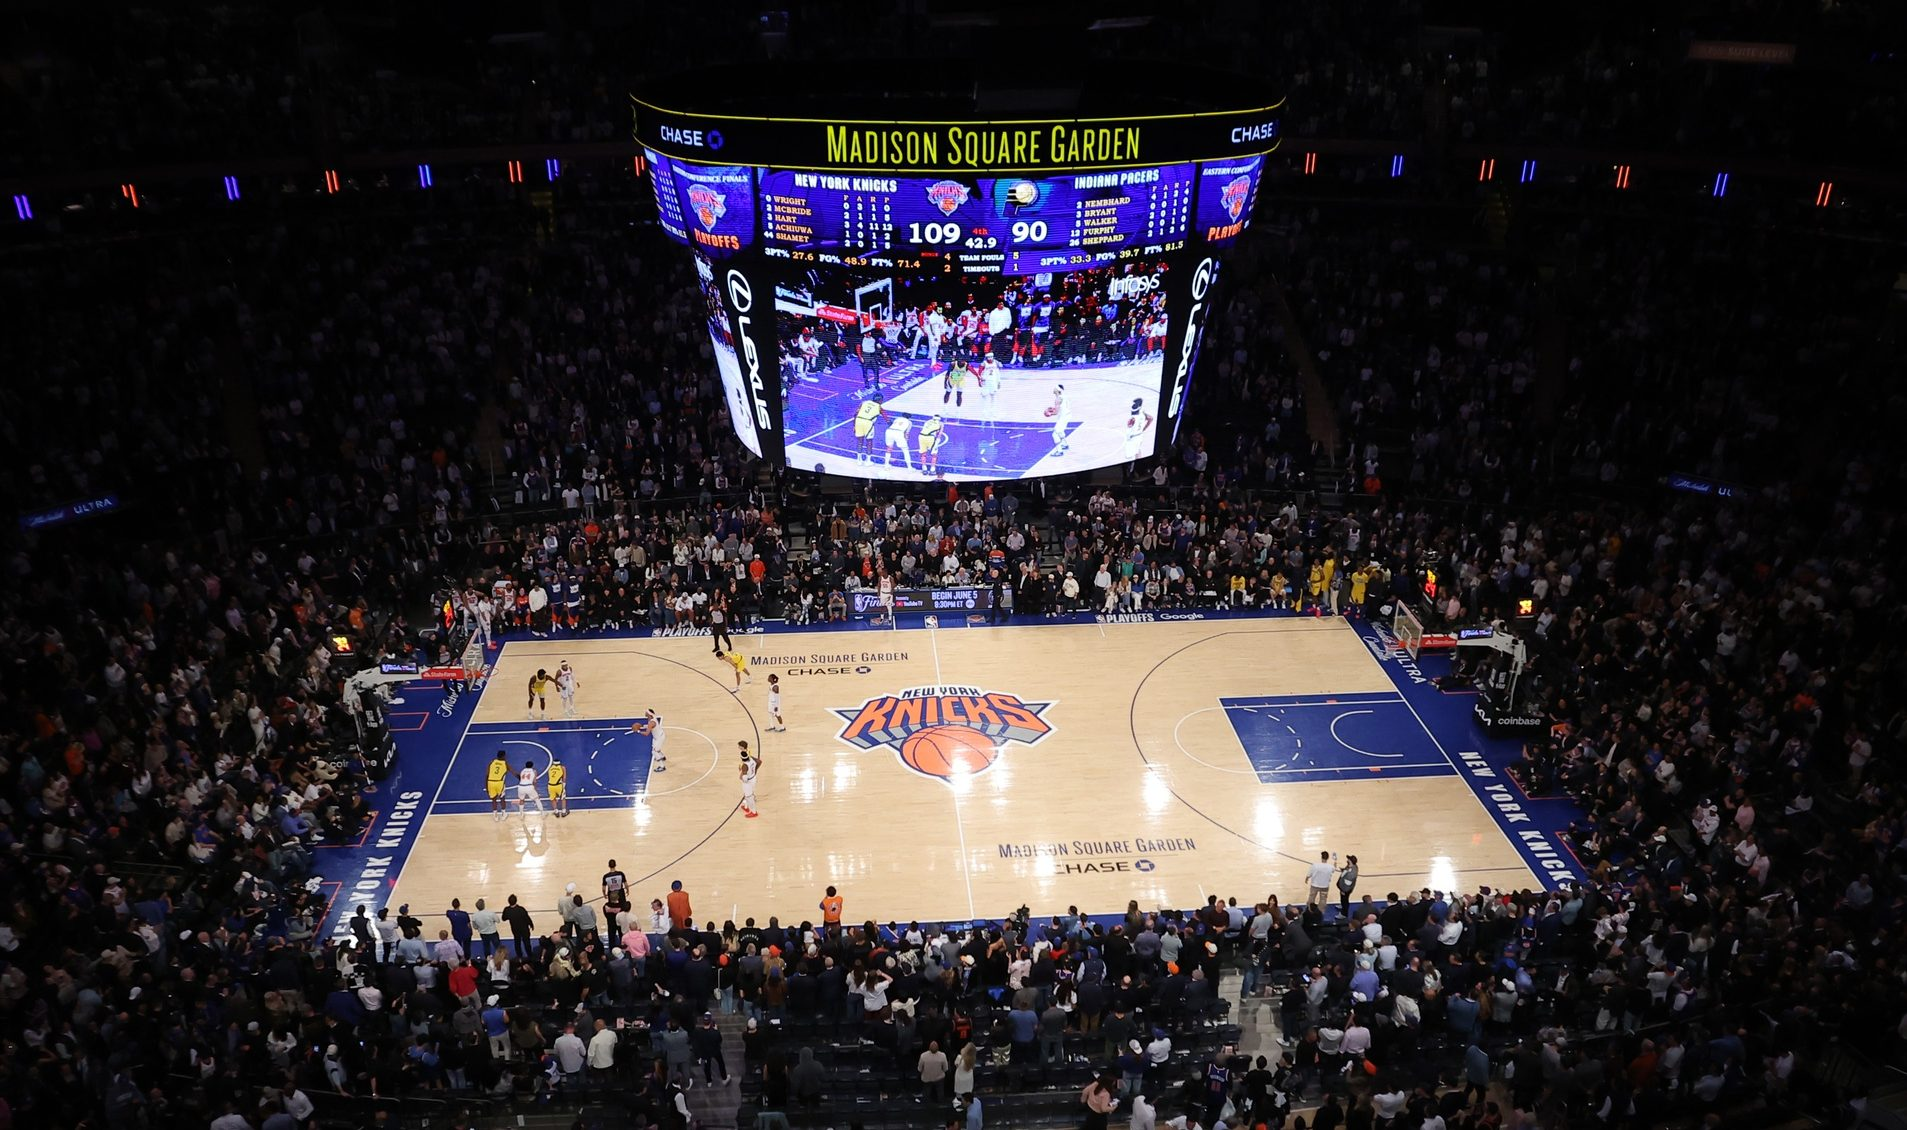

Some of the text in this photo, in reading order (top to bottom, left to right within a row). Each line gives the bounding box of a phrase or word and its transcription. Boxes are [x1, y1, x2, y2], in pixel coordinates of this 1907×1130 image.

[660, 125, 704, 147] CHASE
[1231, 122, 1273, 144] CHASE
[827, 124, 1140, 168] MADISON SQUARE GARDEN
[722, 175, 748, 183] FINALS
[795, 173, 898, 193] NEW YORK KNICKS
[1074, 169, 1160, 190] INDIANA PACERS
[765, 194, 772, 202] 0
[773, 195, 806, 206] WRIGHT
[843, 202, 850, 210] 0
[883, 204, 891, 212] 0
[1076, 201, 1082, 209] 2
[1085, 197, 1131, 208] NEMBHARD
[1151, 193, 1157, 201] 4
[1173, 190, 1179, 198] 2
[1184, 187, 1190, 196] 4
[766, 203, 772, 212] 2
[774, 204, 812, 216] MCBRIDE
[843, 211, 850, 219] 2
[1076, 210, 1082, 219] 3
[1084, 207, 1117, 218] BRYANT
[1150, 202, 1156, 210] 0
[1161, 200, 1167, 209] 0
[1182, 197, 1188, 205] 0
[767, 213, 773, 221] 3
[774, 214, 797, 223] HART
[857, 222, 864, 230] 4
[869, 222, 879, 230] 11
[882, 223, 893, 231] 12
[1070, 229, 1081, 237] 12
[1083, 226, 1116, 236] FURPHY
[1148, 220, 1154, 228] 0
[1159, 219, 1165, 227] 0
[1181, 214, 1187, 223] 0
[1075, 220, 1081, 228] 5
[1083, 217, 1118, 227] WALKER
[1149, 211, 1155, 219] 2
[1160, 209, 1166, 218] 0
[763, 230, 774, 239] 44
[776, 232, 810, 243] SHAMET
[844, 239, 851, 247] 2
[857, 240, 864, 248] 0
[767, 222, 774, 230] 5
[775, 223, 813, 234] ACHIUWA
[857, 231, 864, 239] 0
[884, 232, 891, 240] 2
[909, 222, 961, 244] 109
[1012, 221, 1048, 243] 90
[1069, 238, 1080, 247] 26
[1082, 234, 1124, 245] SHEPPARD
[1147, 229, 1153, 238] 2
[1169, 226, 1175, 234] 2
[965, 237, 997, 249] 42.9
[765, 247, 920, 268] 3PT% 27.6 FG% 48.9 FT% 71.4
[959, 254, 980, 262] TEAM
[1012, 252, 1019, 260] 5
[1040, 240, 1184, 266] 3PT% 33.3 FG% 39.7 FT% 81.5
[1013, 263, 1019, 271] 1
[1111, 273, 1160, 295] Infosys
[1168, 302, 1202, 419] LEXUS
[738, 315, 772, 430] LEXUS
[73, 498, 113, 514] ULTRA
[931, 590, 978, 600] BEGIN JUNE 5
[1106, 613, 1205, 623] PLAYOFFS Google
[662, 627, 712, 637] PLAYOFFS
[751, 652, 909, 666] MADISON SQUARE GARDEN
[1394, 651, 1426, 684] ULTRA
[787, 667, 851, 676] CHASE
[902, 687, 981, 698] NEW YORK
[840, 693, 1052, 744] KNICKS
[1498, 716, 1541, 725] coinbase
[494, 766, 500, 774] 3
[1459, 752, 1496, 777] NEW
[1485, 784, 1531, 823] YORK
[349, 791, 423, 902] YORK KNICKS
[1072, 841, 1132, 855] SQUARE
[1136, 838, 1196, 851] GARDEN
